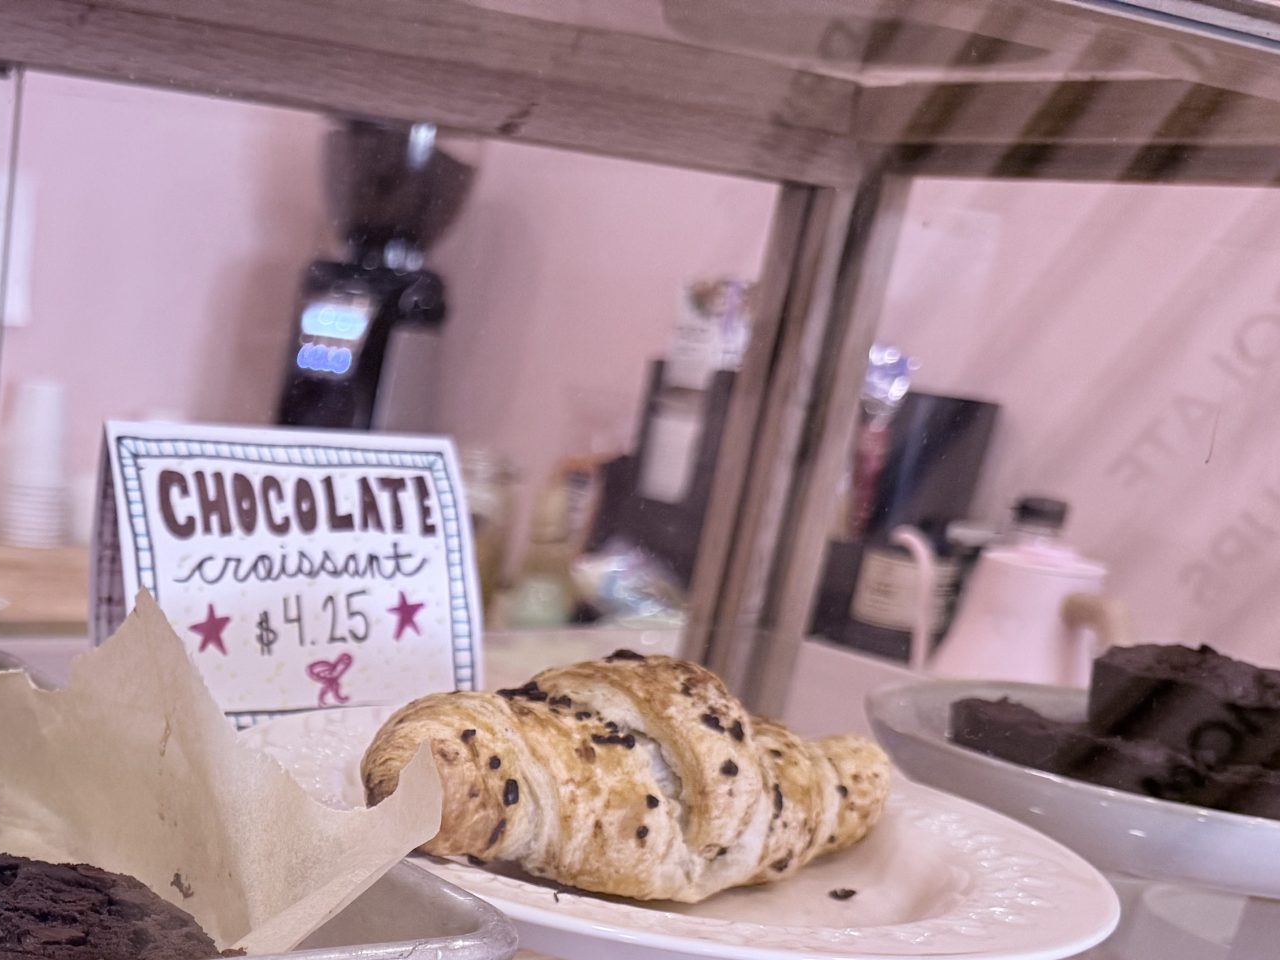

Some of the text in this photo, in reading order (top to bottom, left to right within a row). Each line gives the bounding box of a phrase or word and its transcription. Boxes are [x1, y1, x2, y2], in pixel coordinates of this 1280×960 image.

[157, 469, 437, 540] CHOCOLATE
[172, 542, 429, 583] croissant
[256, 589, 371, 655] $4.25
